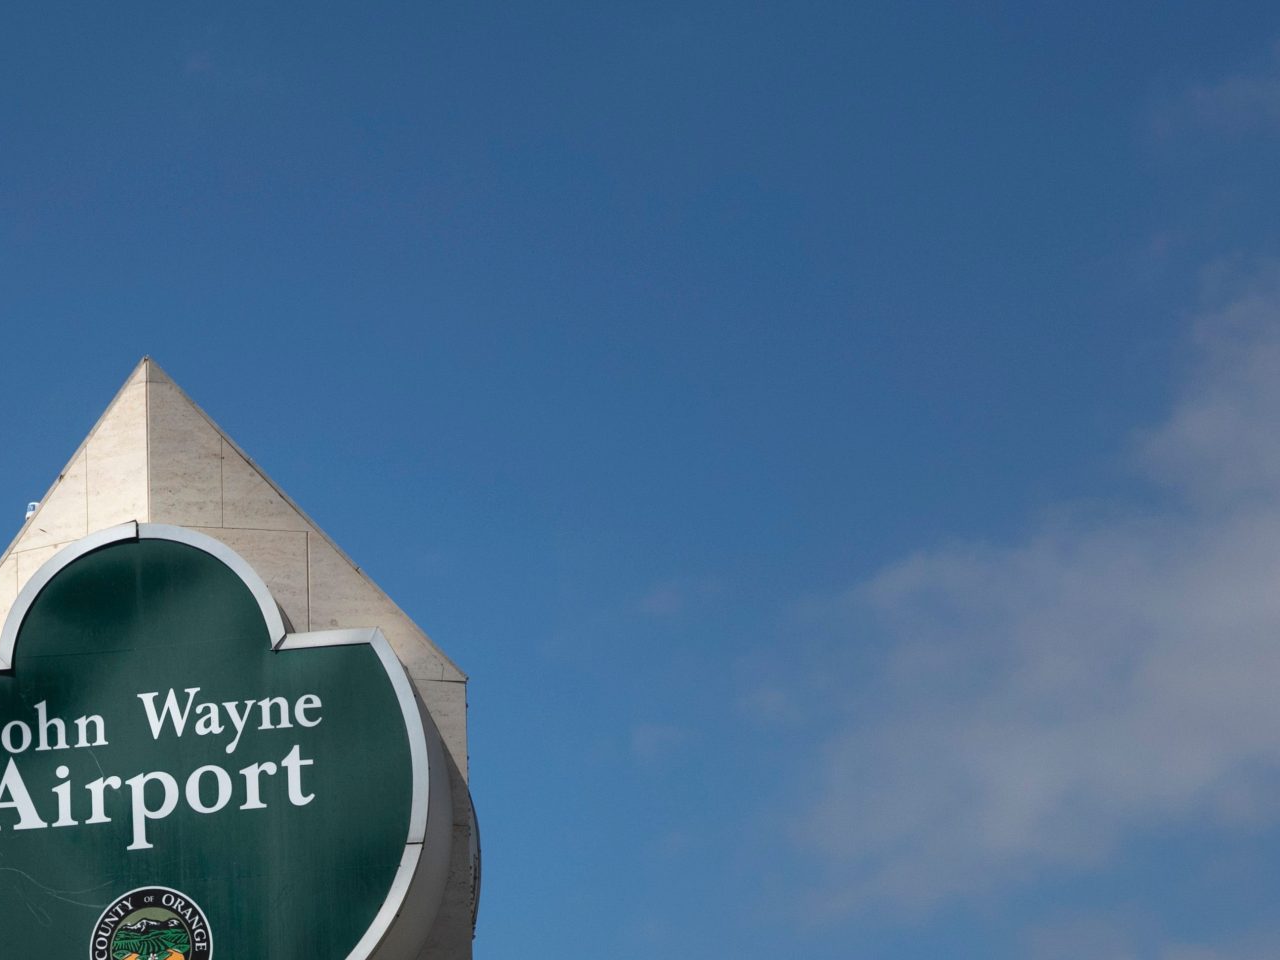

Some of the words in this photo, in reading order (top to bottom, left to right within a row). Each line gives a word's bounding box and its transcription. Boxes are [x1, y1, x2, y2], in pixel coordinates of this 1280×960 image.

[136, 686, 323, 754] Wayne
[95, 897, 134, 960] COUNTY
[143, 895, 155, 903] OF
[161, 893, 207, 952] ORANGE
